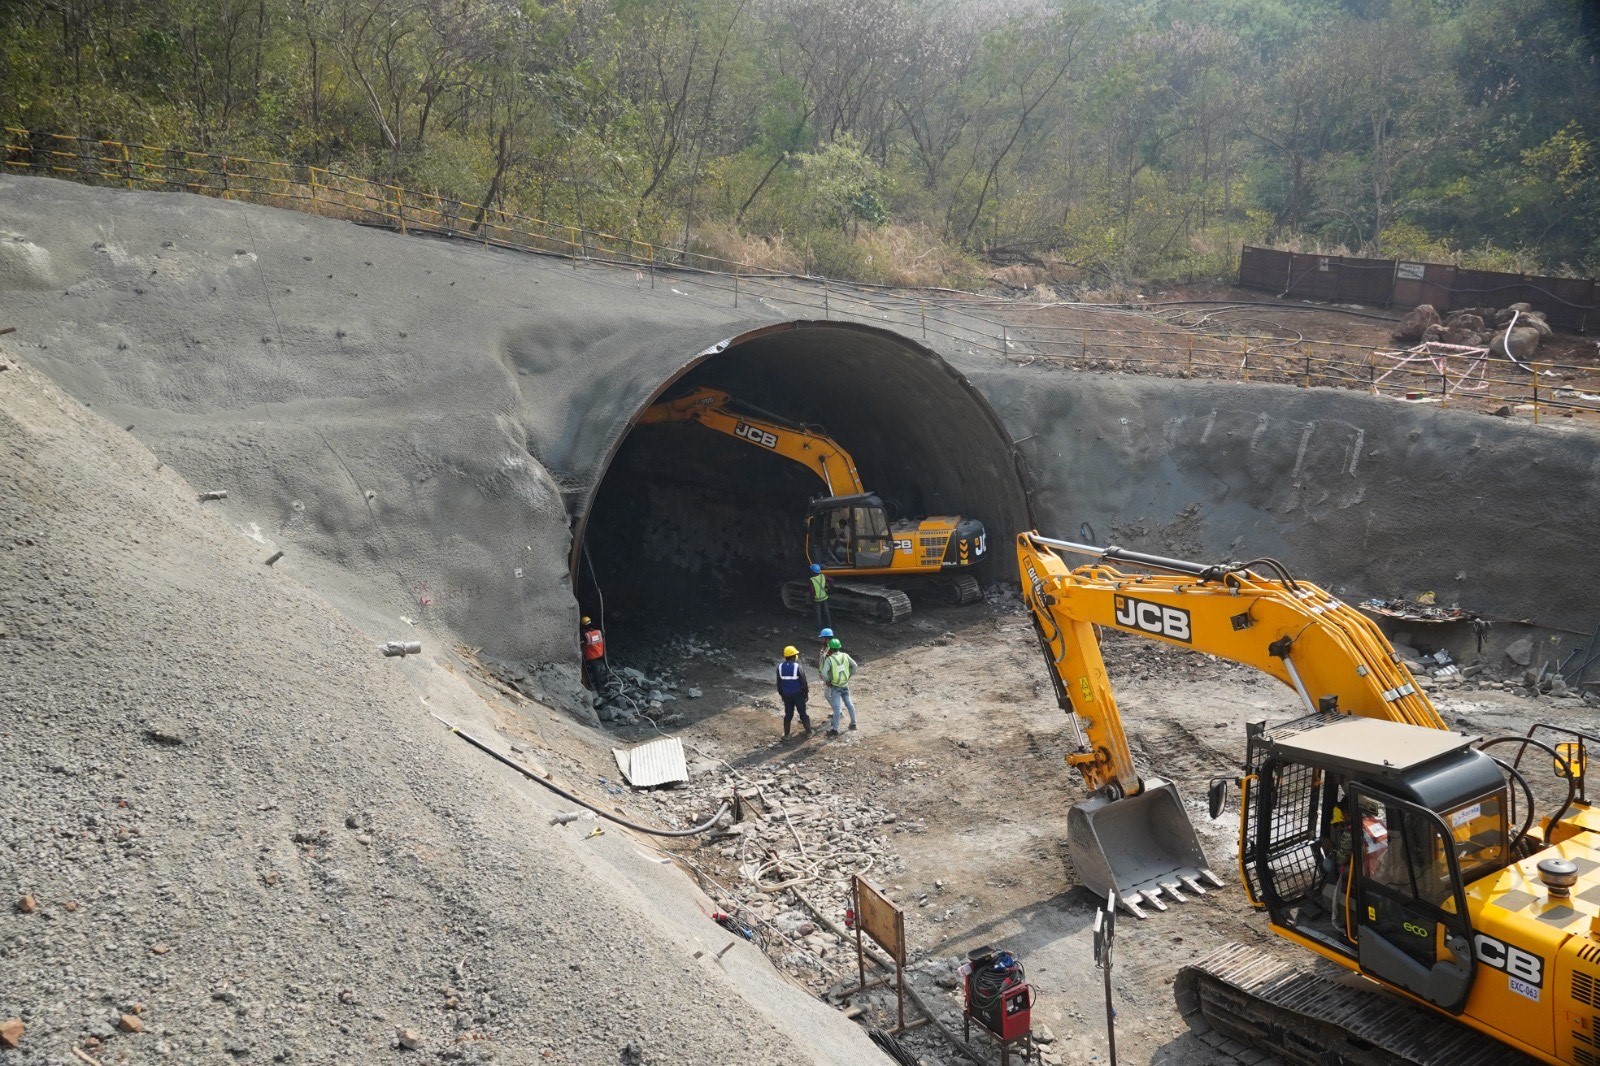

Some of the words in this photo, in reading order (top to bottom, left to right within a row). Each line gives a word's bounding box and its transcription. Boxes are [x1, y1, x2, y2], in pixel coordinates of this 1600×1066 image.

[735, 425, 778, 448] JCB
[1116, 599, 1190, 639] JCB
[1403, 922, 1428, 937] eco
[1447, 931, 1541, 984] CB
[1510, 980, 1538, 999] EXC-063
